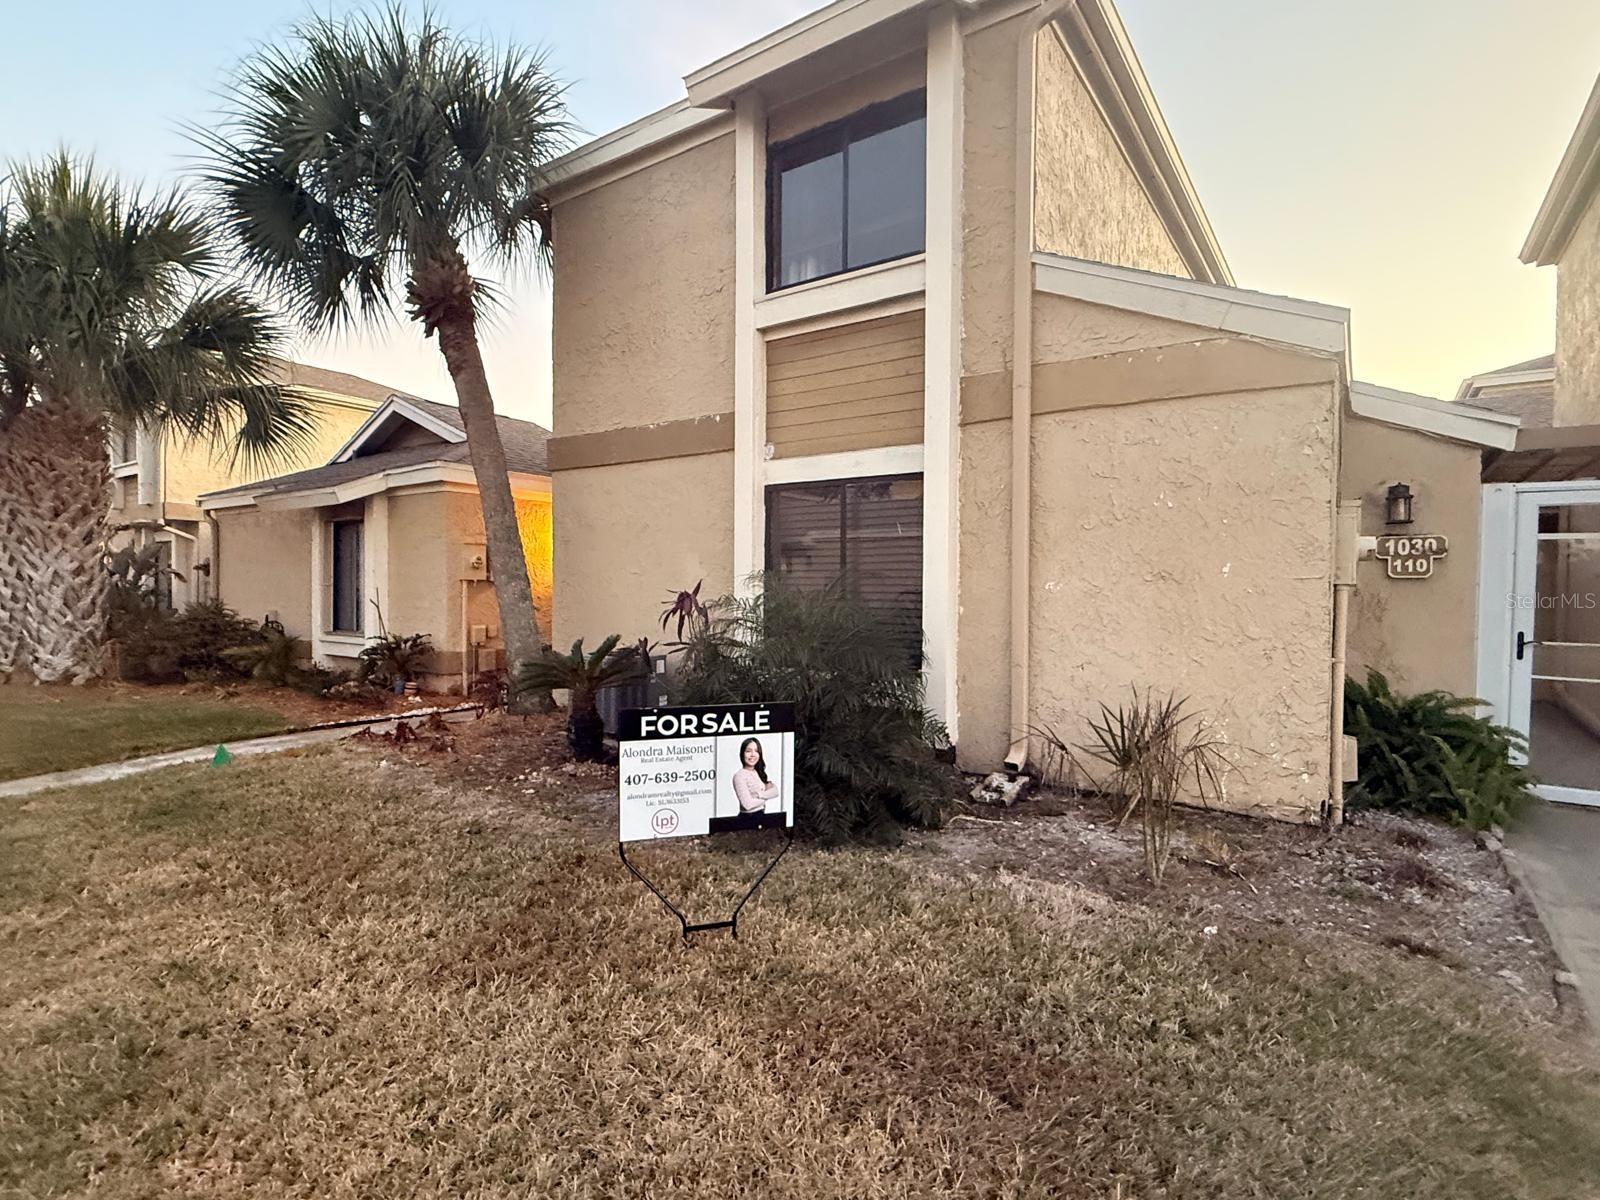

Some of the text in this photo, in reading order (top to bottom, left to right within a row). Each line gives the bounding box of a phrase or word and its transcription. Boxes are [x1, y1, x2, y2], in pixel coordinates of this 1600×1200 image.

[1385, 538, 1437, 555] 1030
[1393, 558, 1428, 572] 110
[641, 710, 770, 737] FOR SALE
[622, 744, 714, 758] Alondra Maisonet
[624, 769, 716, 785] 407-639-2500
[655, 815, 675, 829] lpt
